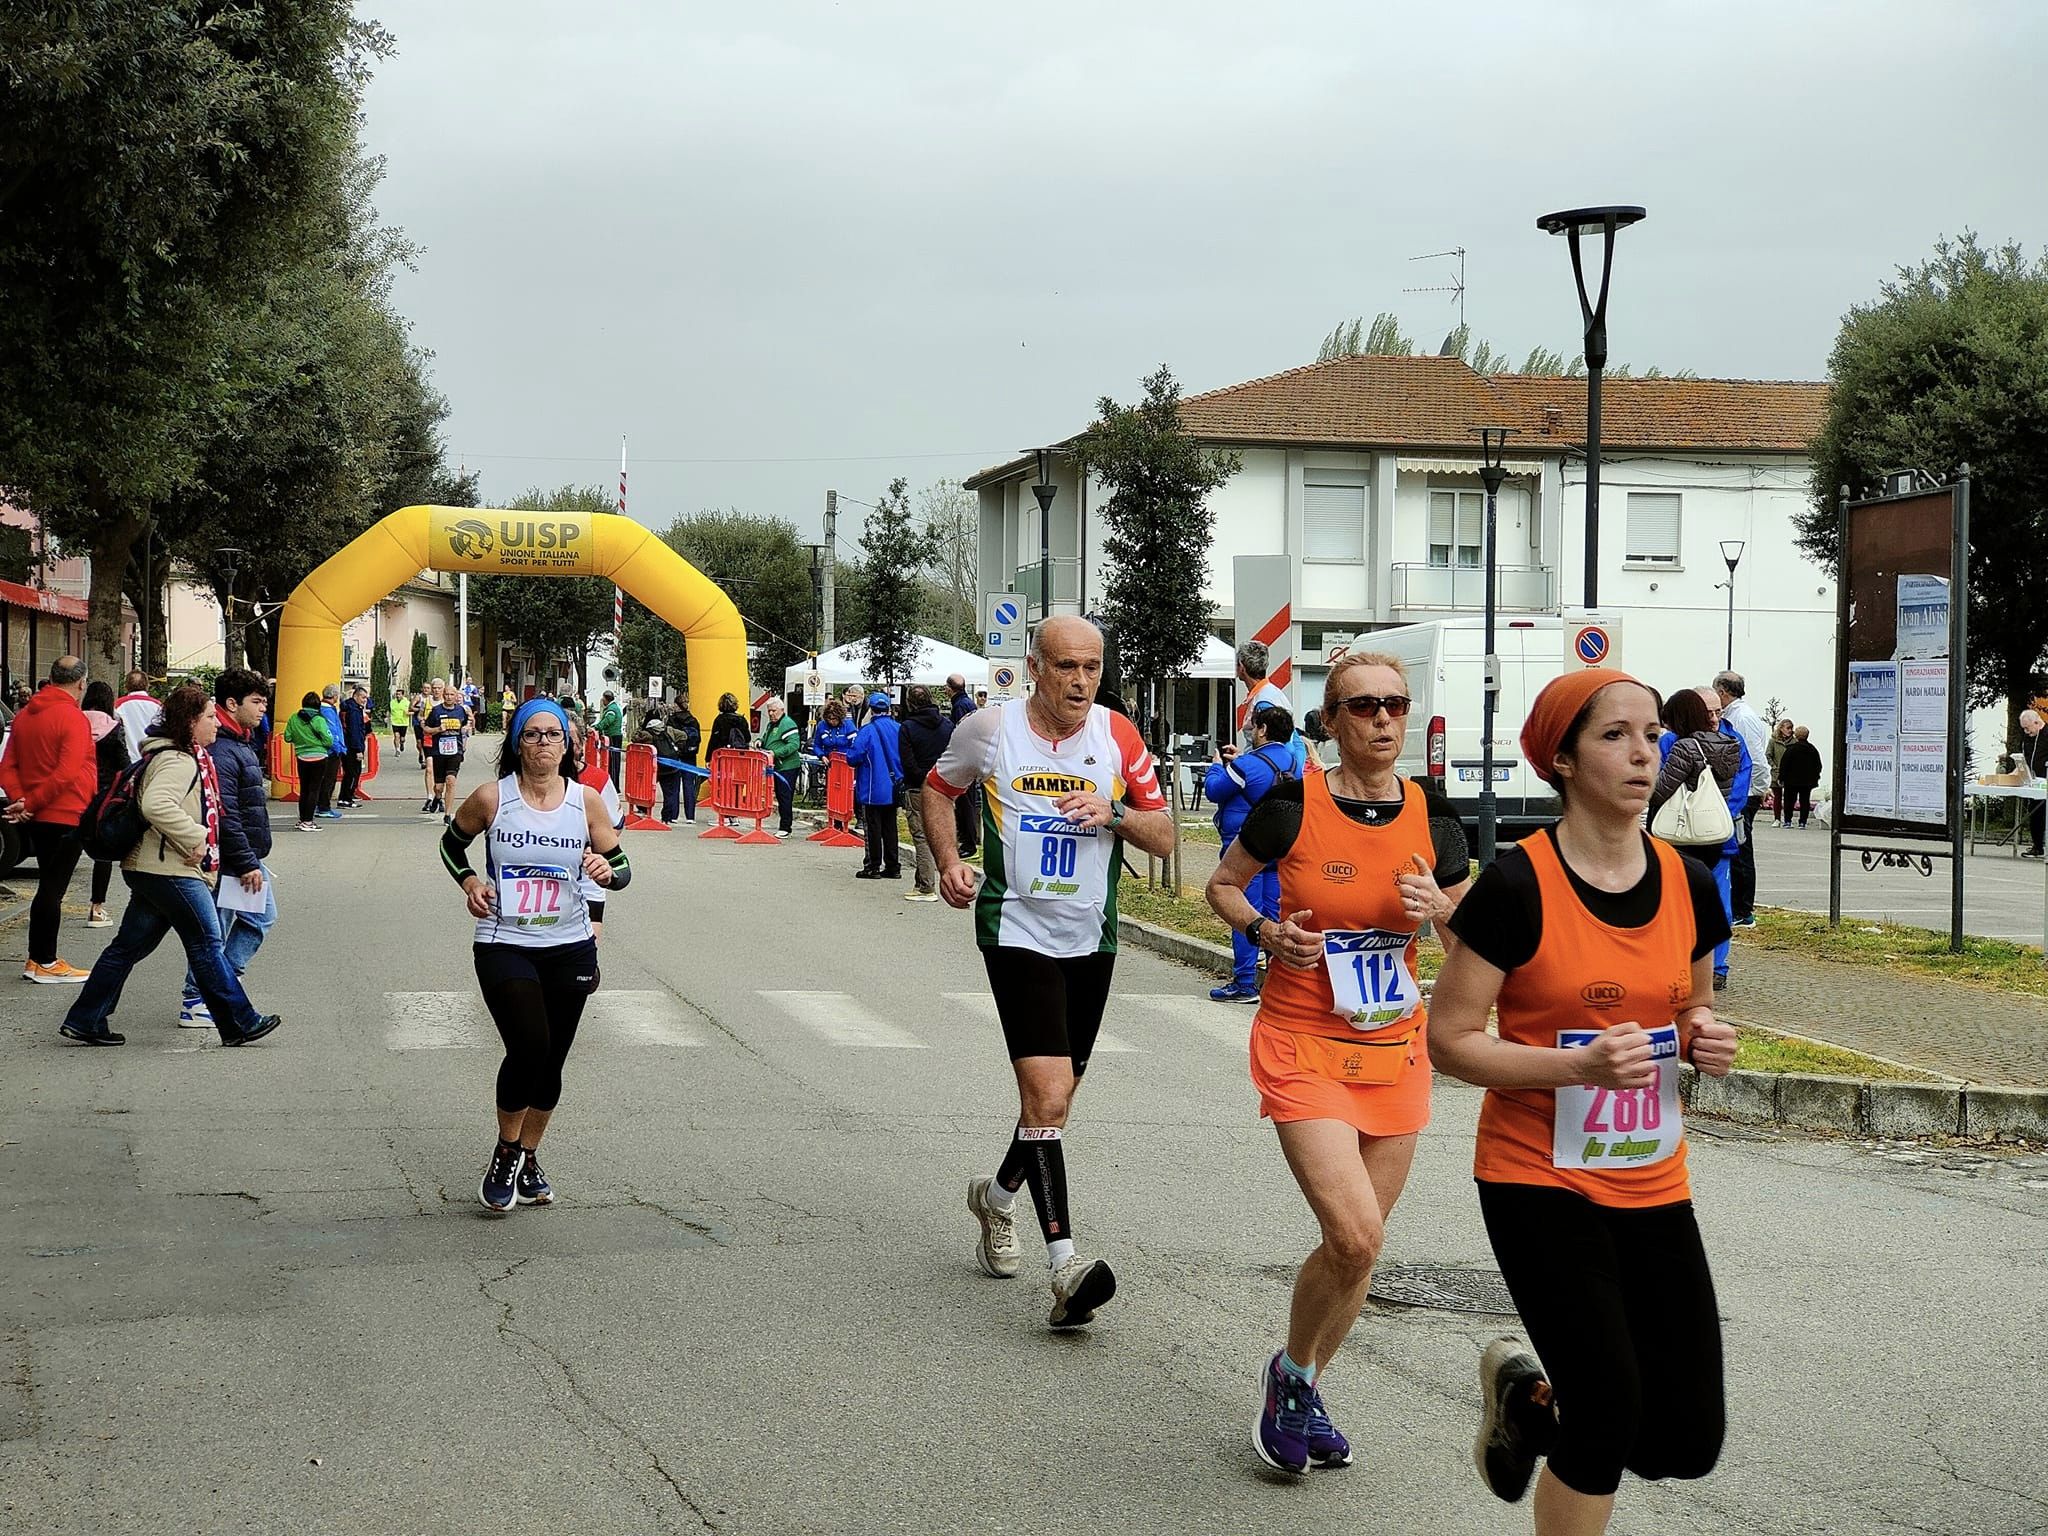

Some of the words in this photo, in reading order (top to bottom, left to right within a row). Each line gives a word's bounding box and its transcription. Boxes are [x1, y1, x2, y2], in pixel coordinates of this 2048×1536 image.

[500, 521, 580, 549] UISP
[500, 549, 536, 558] UNIONE
[539, 551, 580, 560] ITALIANA
[500, 558, 528, 566] SPORT
[532, 559, 547, 567] PER
[1900, 607, 1920, 627] Ivan
[1852, 759, 1874, 771] ALVISI
[1875, 760, 1893, 772] IVAN
[1022, 777, 1086, 792] MAMELI
[496, 828, 582, 849] lughesina
[1040, 836, 1077, 878] 80
[1326, 864, 1352, 876] LUCCI
[516, 879, 561, 914] 272
[1351, 952, 1405, 1005] 112
[1587, 987, 1620, 999] LUCCI
